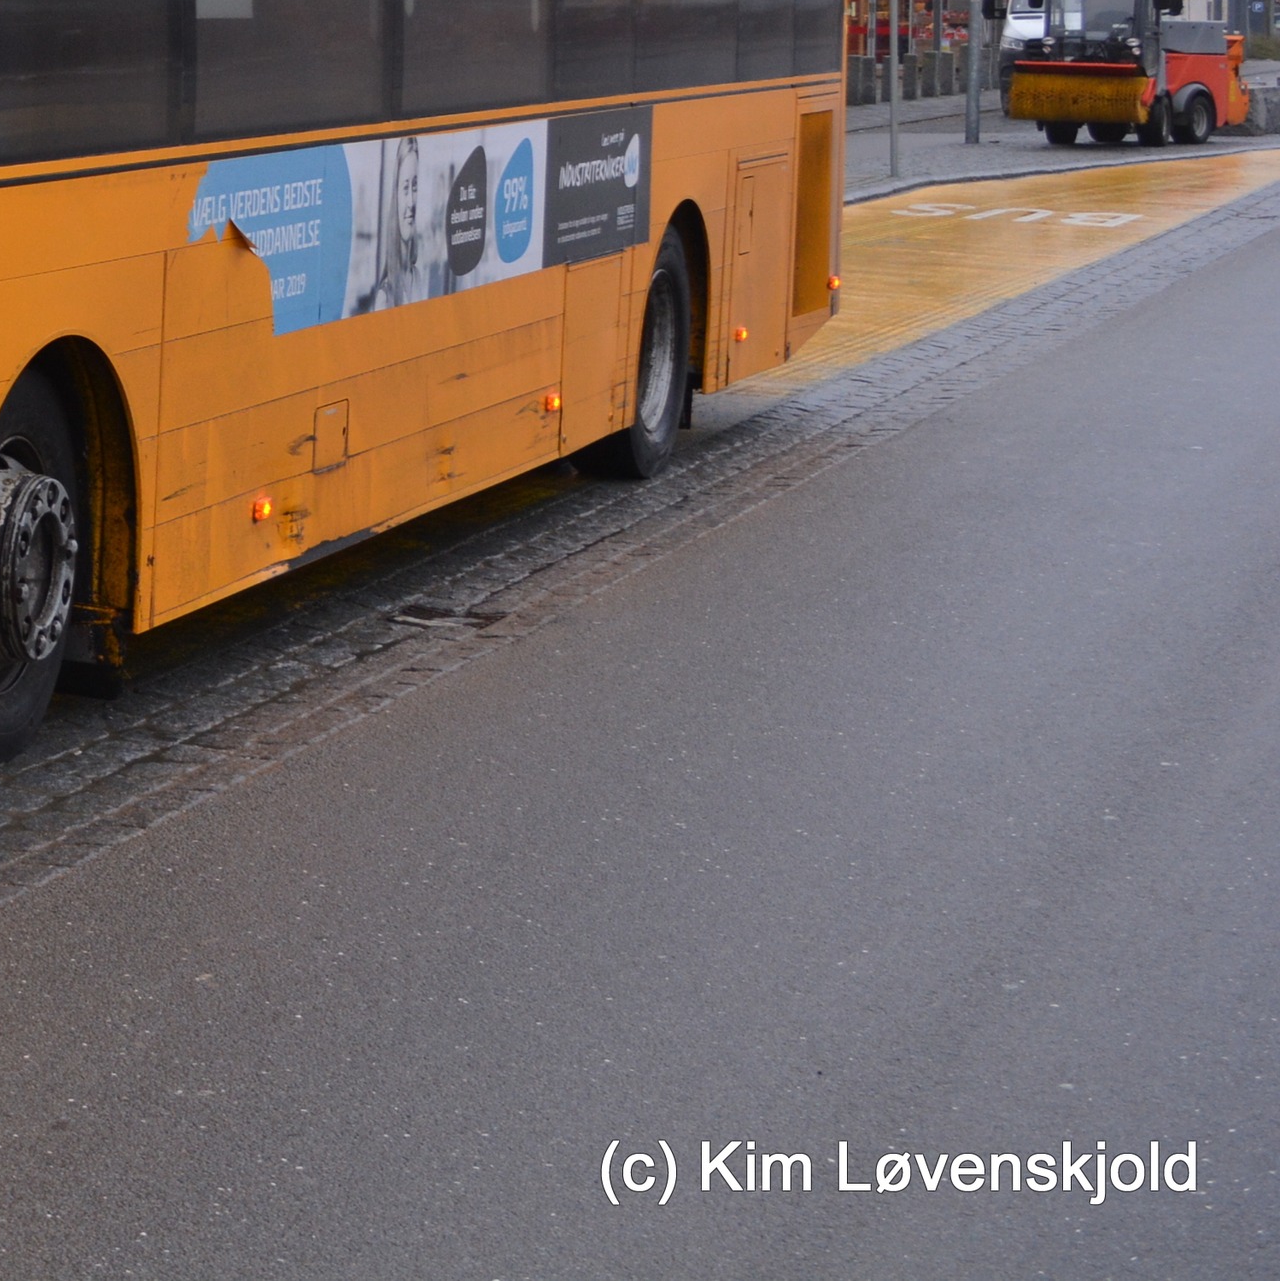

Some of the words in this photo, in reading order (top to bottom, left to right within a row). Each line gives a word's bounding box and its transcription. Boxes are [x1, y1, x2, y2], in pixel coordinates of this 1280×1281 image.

[193, 194, 226, 227] VÆLG
[229, 185, 281, 220] VERDENS
[283, 178, 323, 211] BEDSTE
[460, 186, 467, 201] Du
[503, 176, 529, 213] 99%
[890, 203, 1144, 228] BUS
[286, 273, 306, 297] 2019
